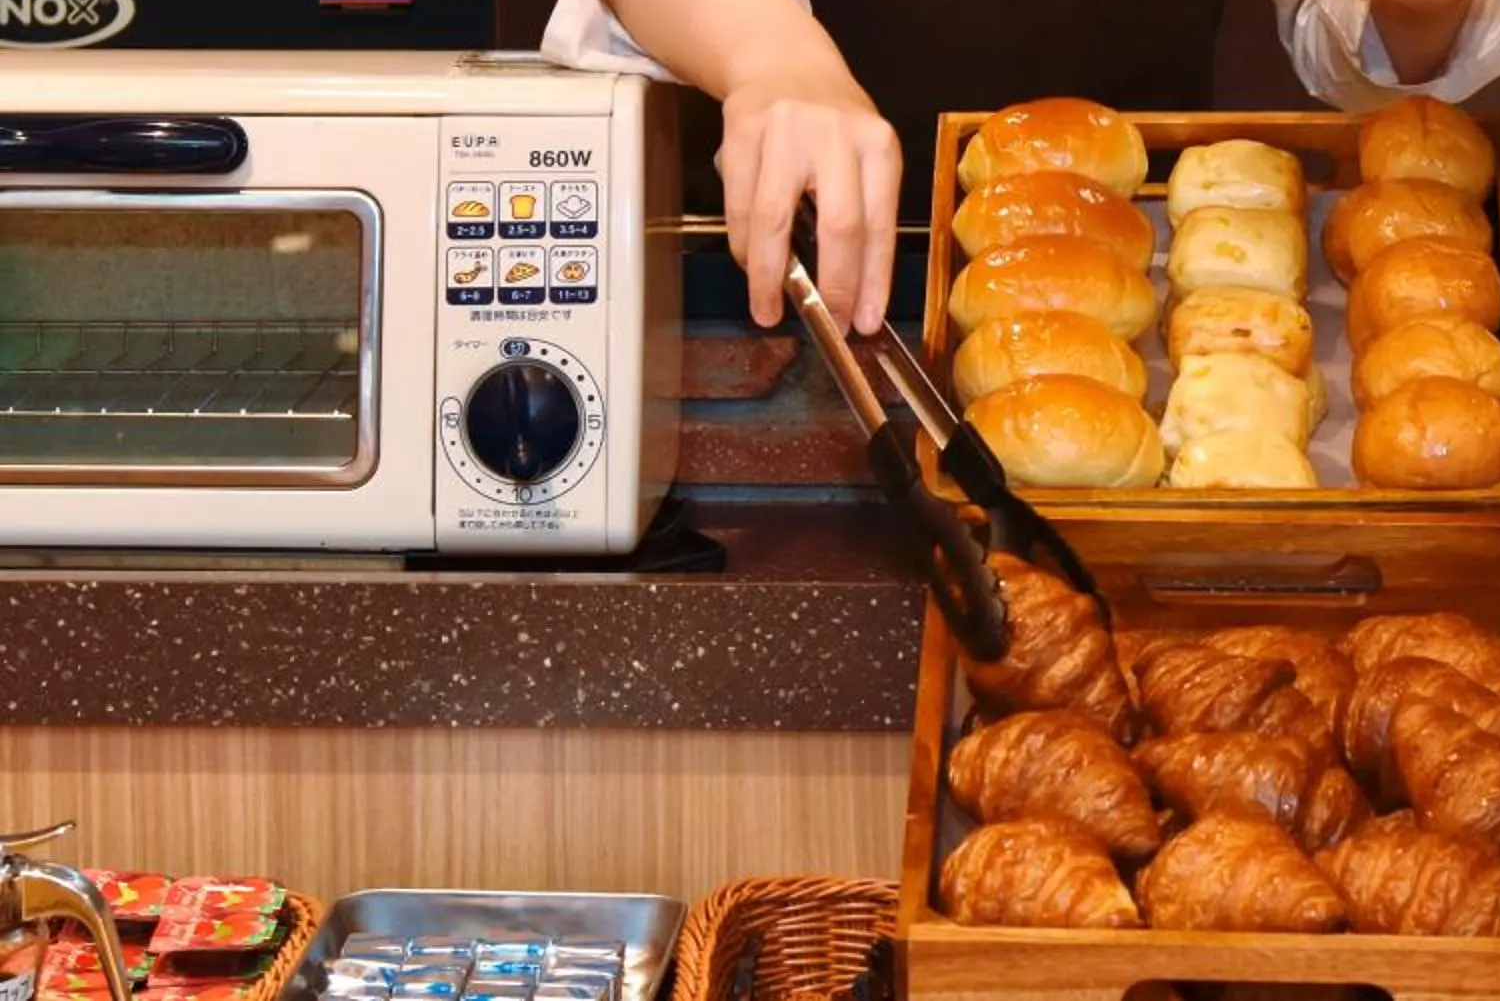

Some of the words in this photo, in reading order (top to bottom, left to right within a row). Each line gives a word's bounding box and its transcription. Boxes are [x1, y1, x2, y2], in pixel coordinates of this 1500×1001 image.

[451, 136, 498, 148] EUPA
[529, 150, 592, 168] 860W
[587, 413, 602, 430] 5
[511, 488, 533, 503] 10
